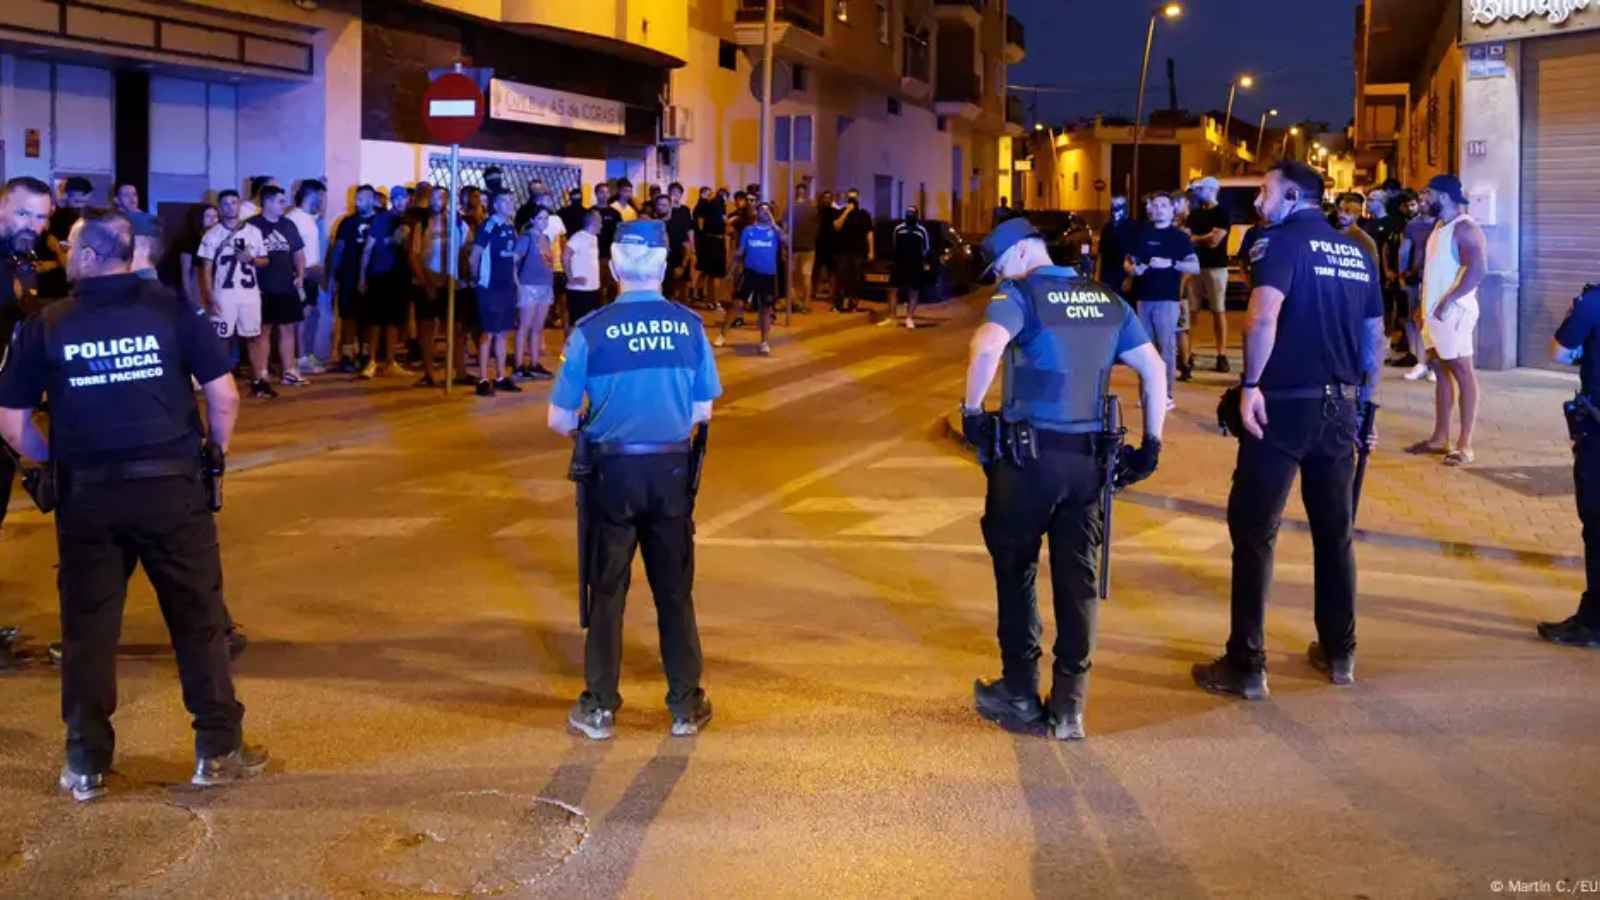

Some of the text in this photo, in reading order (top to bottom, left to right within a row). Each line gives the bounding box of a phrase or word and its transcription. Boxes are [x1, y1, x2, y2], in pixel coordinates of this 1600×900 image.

[1309, 240, 1363, 259] POLICIA
[1047, 291, 1111, 304] GUARDIA
[1066, 305, 1105, 319] CIVIL
[605, 320, 690, 339] GUARDIA
[63, 335, 160, 361] POLICIA
[628, 336, 676, 352] CIVIL
[114, 352, 162, 370] LOCAL
[69, 367, 164, 387] TORRE PACHECO
